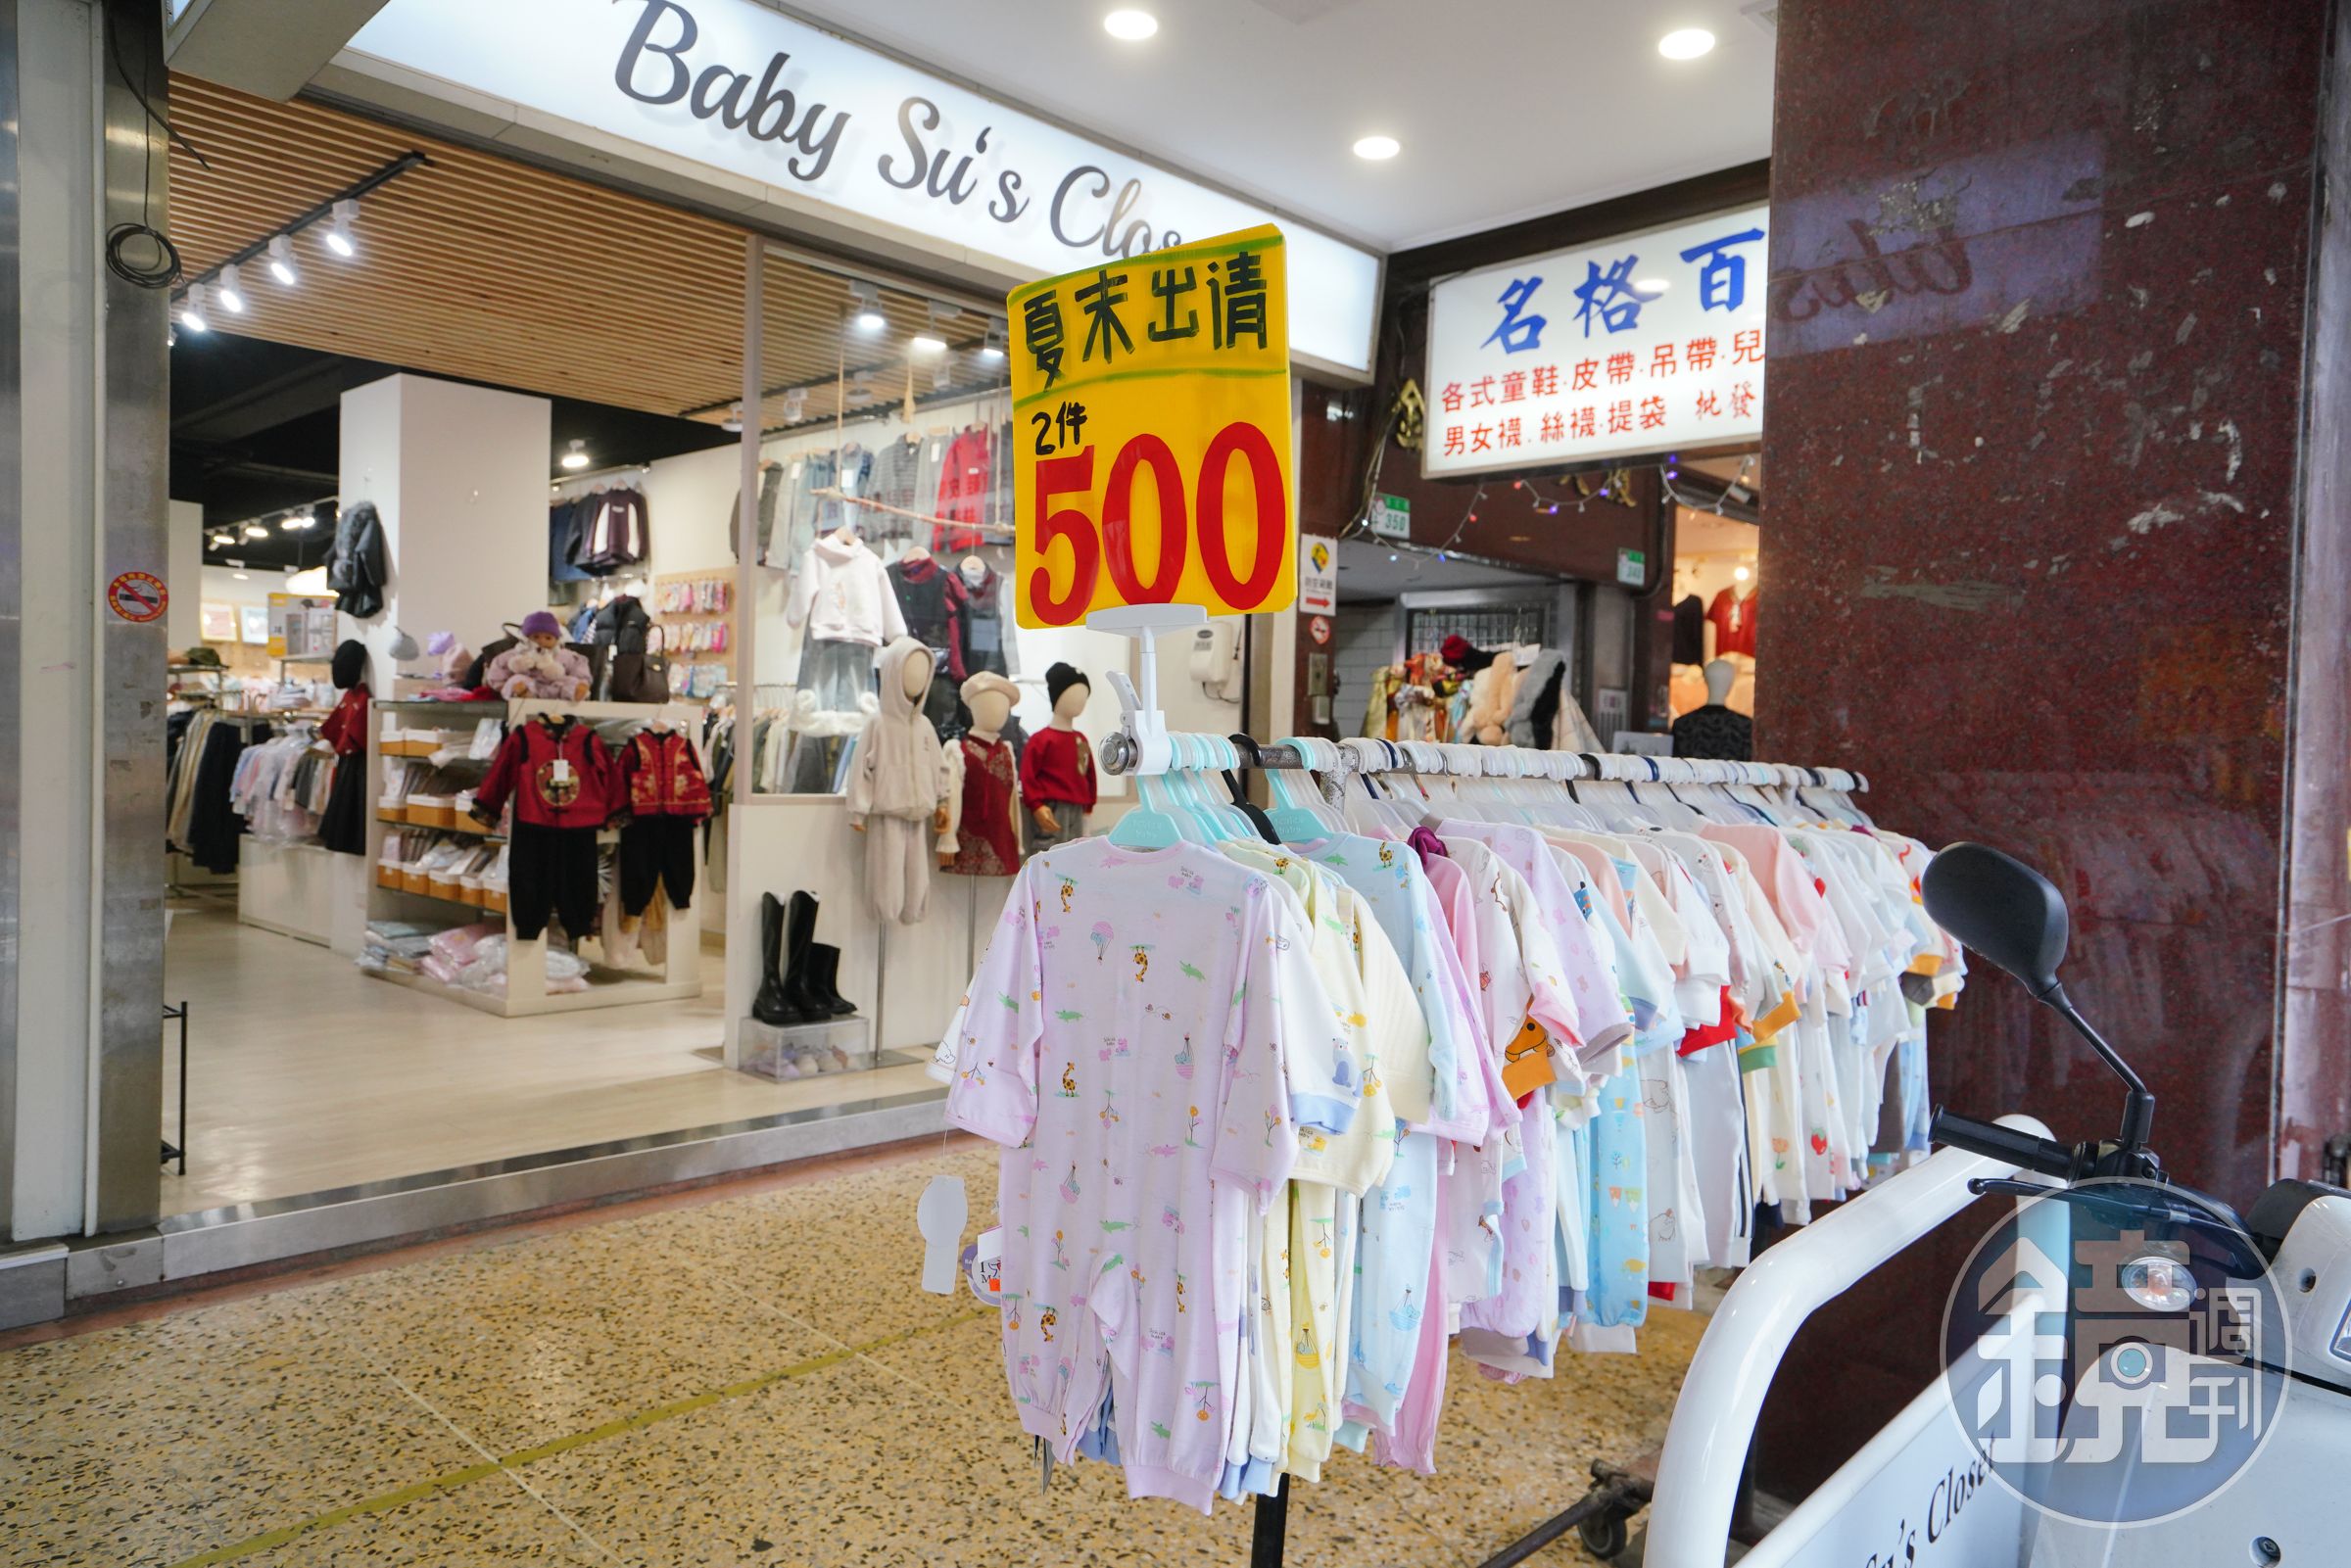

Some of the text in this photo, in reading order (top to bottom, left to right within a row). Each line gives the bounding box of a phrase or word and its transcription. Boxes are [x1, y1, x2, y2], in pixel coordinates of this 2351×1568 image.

[612, 0, 851, 181] Baby
[1032, 402, 1087, 455] 2件
[1030, 421, 1286, 626] 500
[1927, 1428, 1996, 1544] Closet
